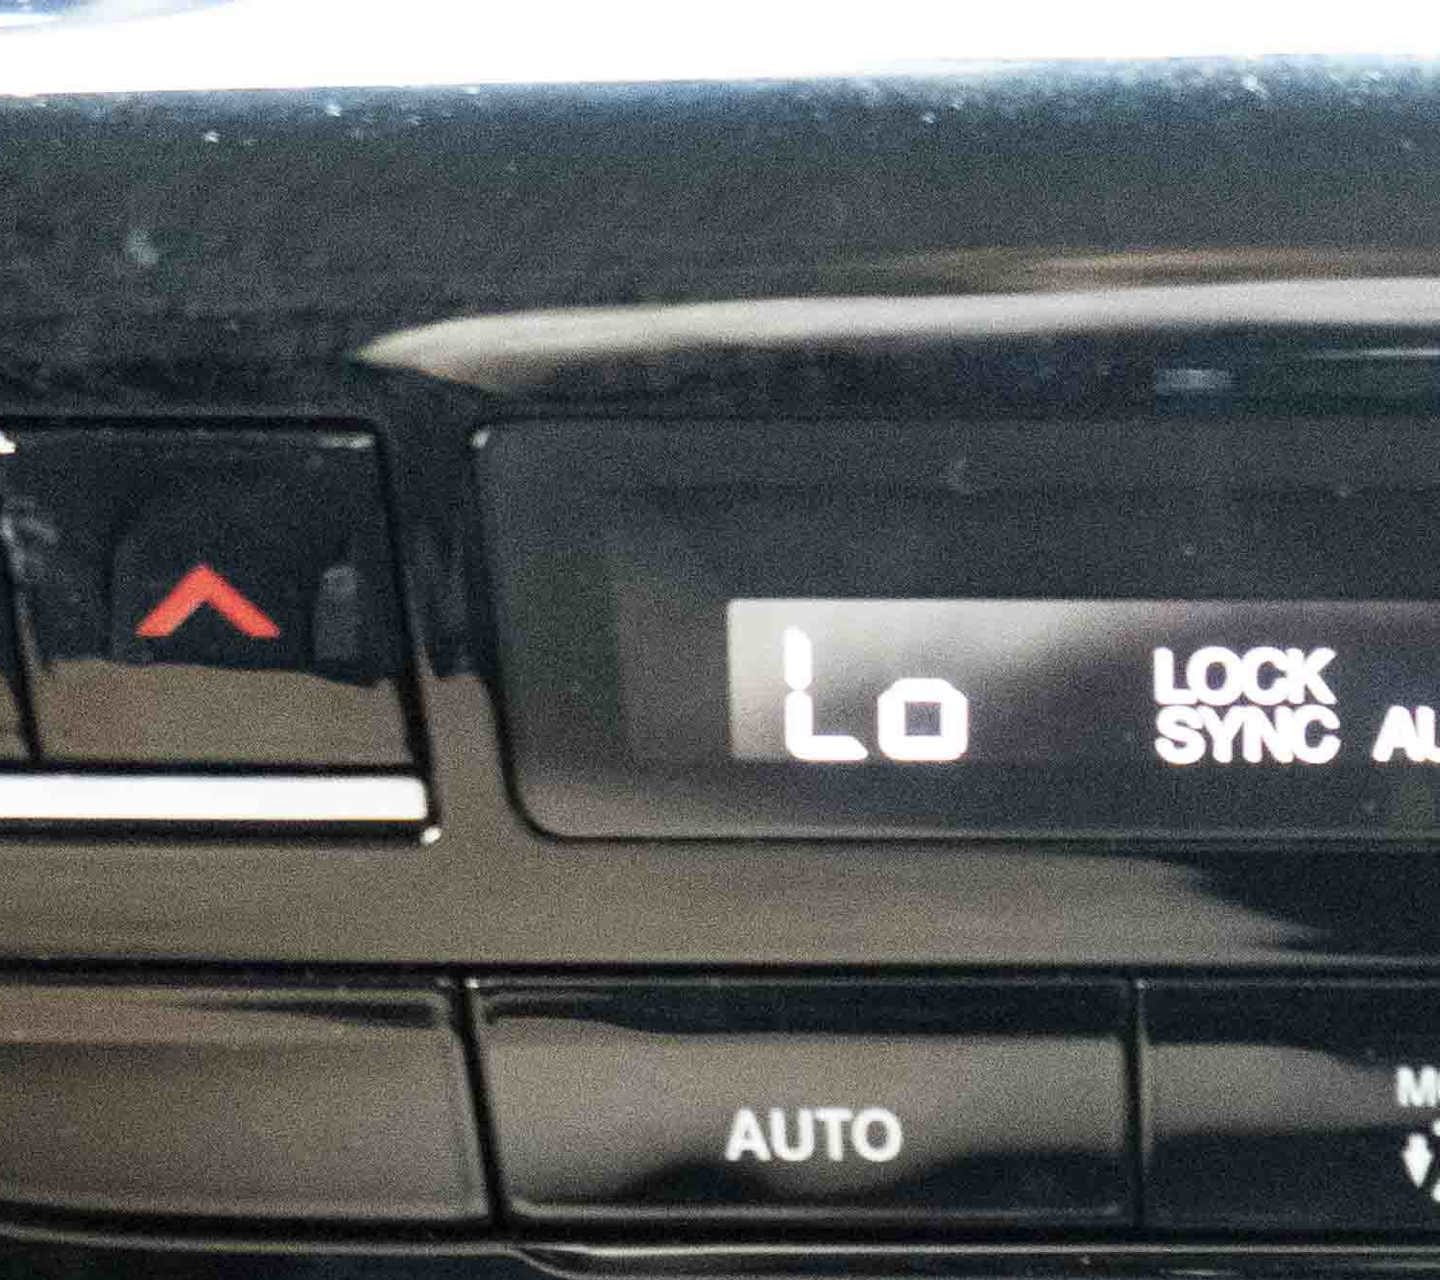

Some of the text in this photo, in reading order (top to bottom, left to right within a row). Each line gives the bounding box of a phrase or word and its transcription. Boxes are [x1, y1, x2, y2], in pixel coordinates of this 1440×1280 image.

[783, 626, 969, 762] Lo
[1153, 645, 1338, 706] LOCK
[1154, 704, 1342, 765] SYNC
[724, 1106, 905, 1163] AUTO
